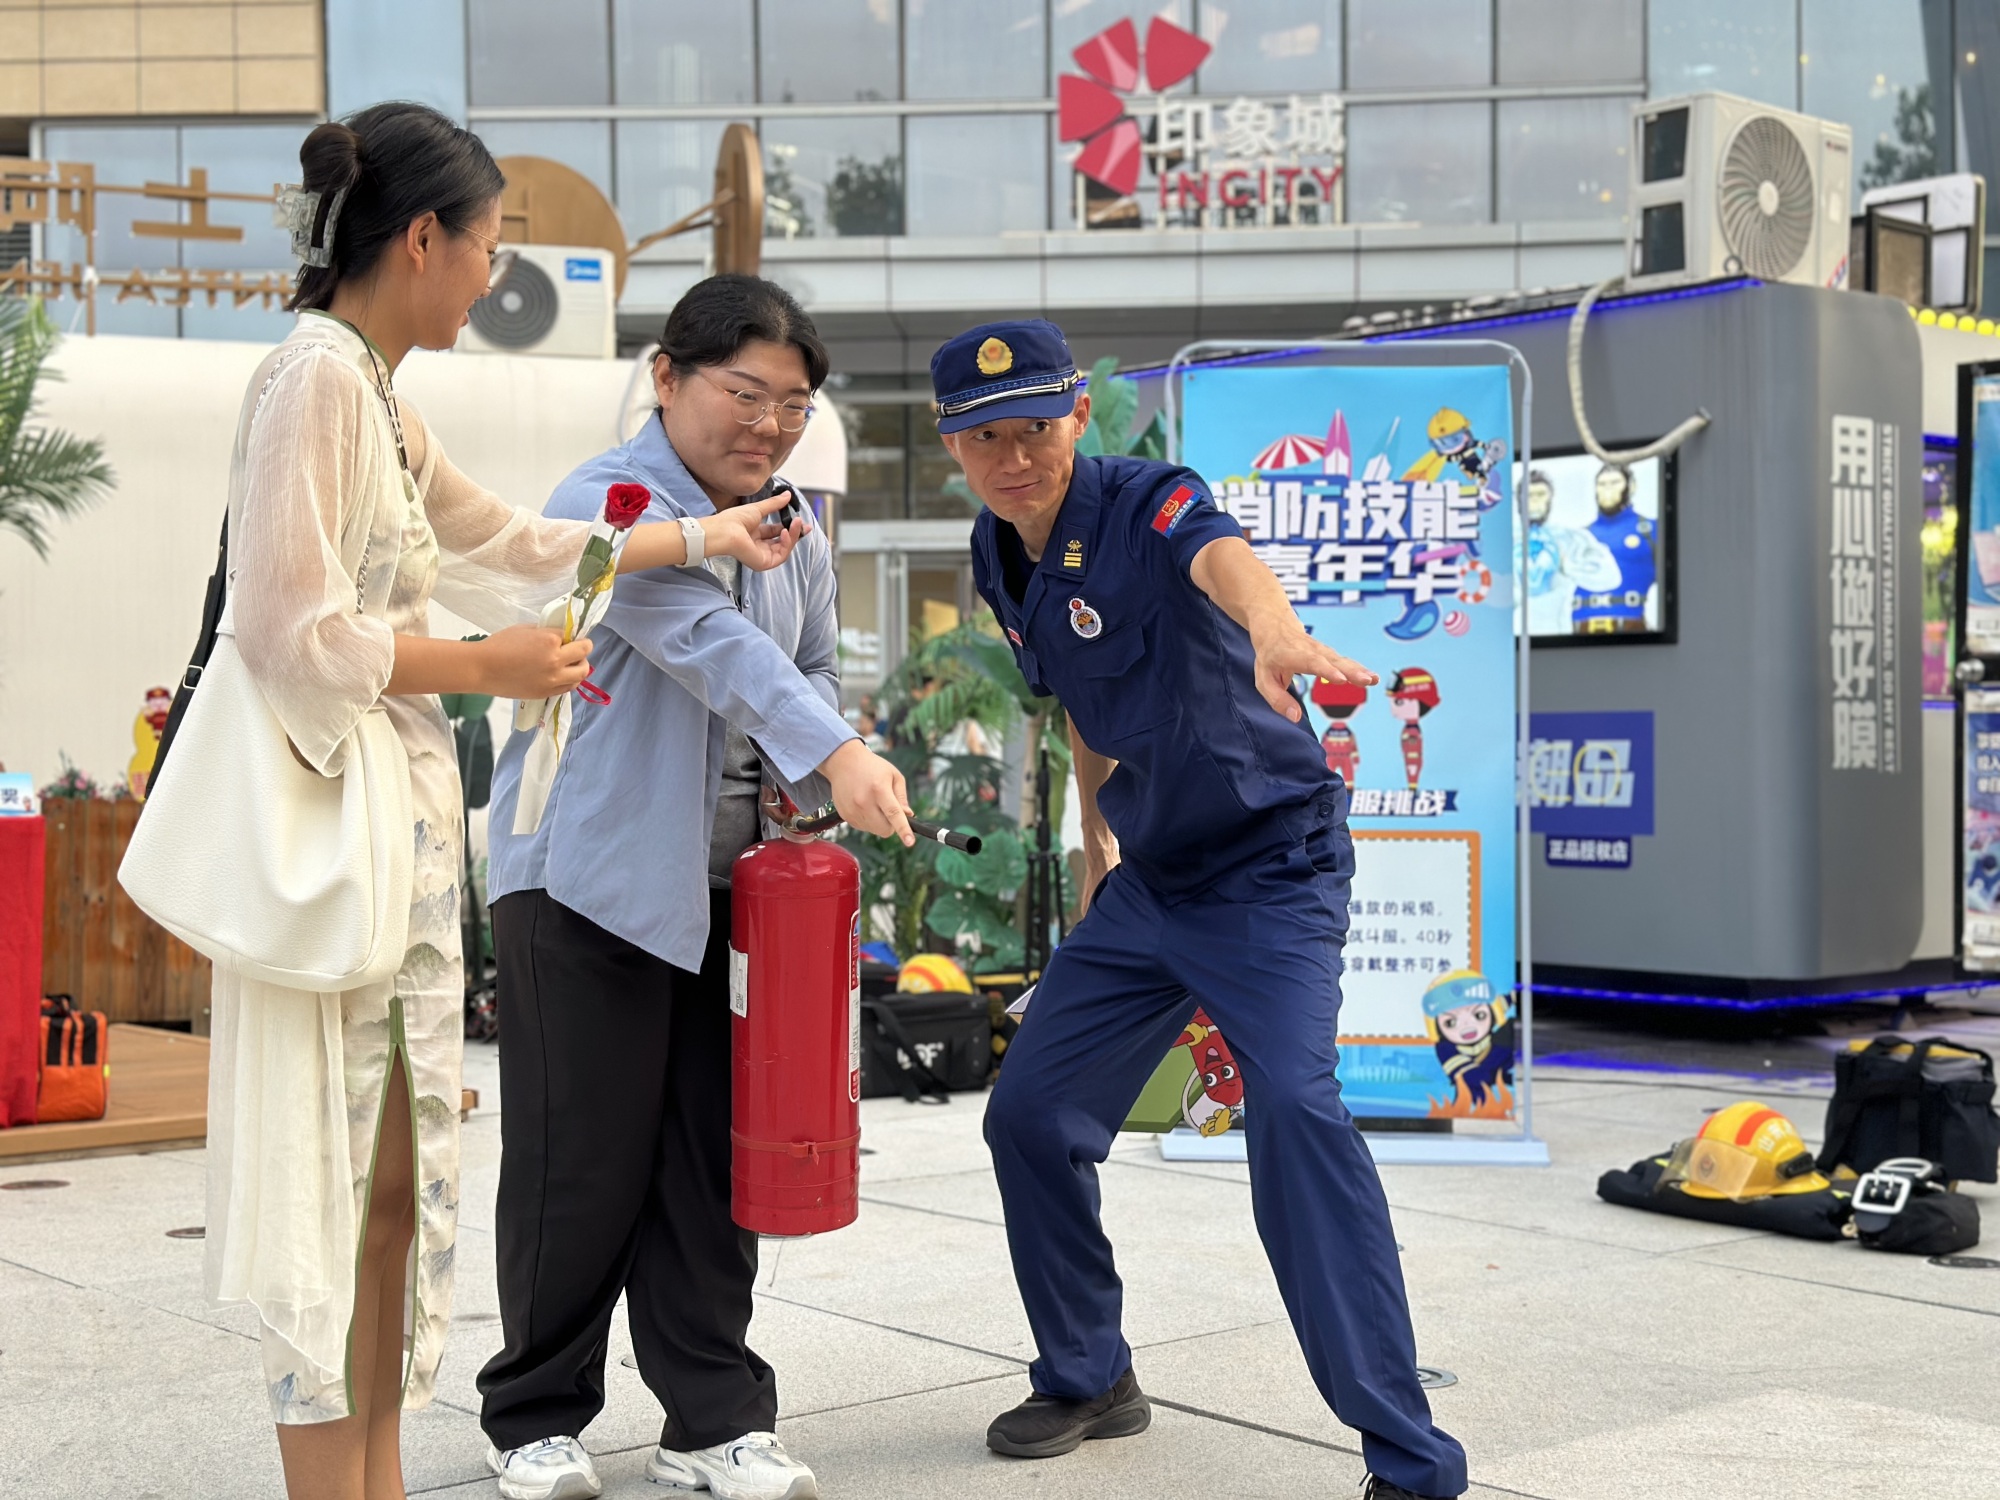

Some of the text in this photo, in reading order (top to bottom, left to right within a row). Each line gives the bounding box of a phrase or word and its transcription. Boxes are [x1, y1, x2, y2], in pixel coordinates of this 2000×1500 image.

[1157, 94, 1344, 158] 印象城
[1160, 166, 1344, 210] INCITY
[1881, 423, 1893, 486] STRICT
[1210, 480, 1479, 540] 消防技能
[1882, 489, 1894, 564] QUALITY
[1252, 541, 1465, 604] 嘉年华
[1830, 414, 1877, 770] 用心做好膜
[1349, 789, 1448, 816] 服挑战
